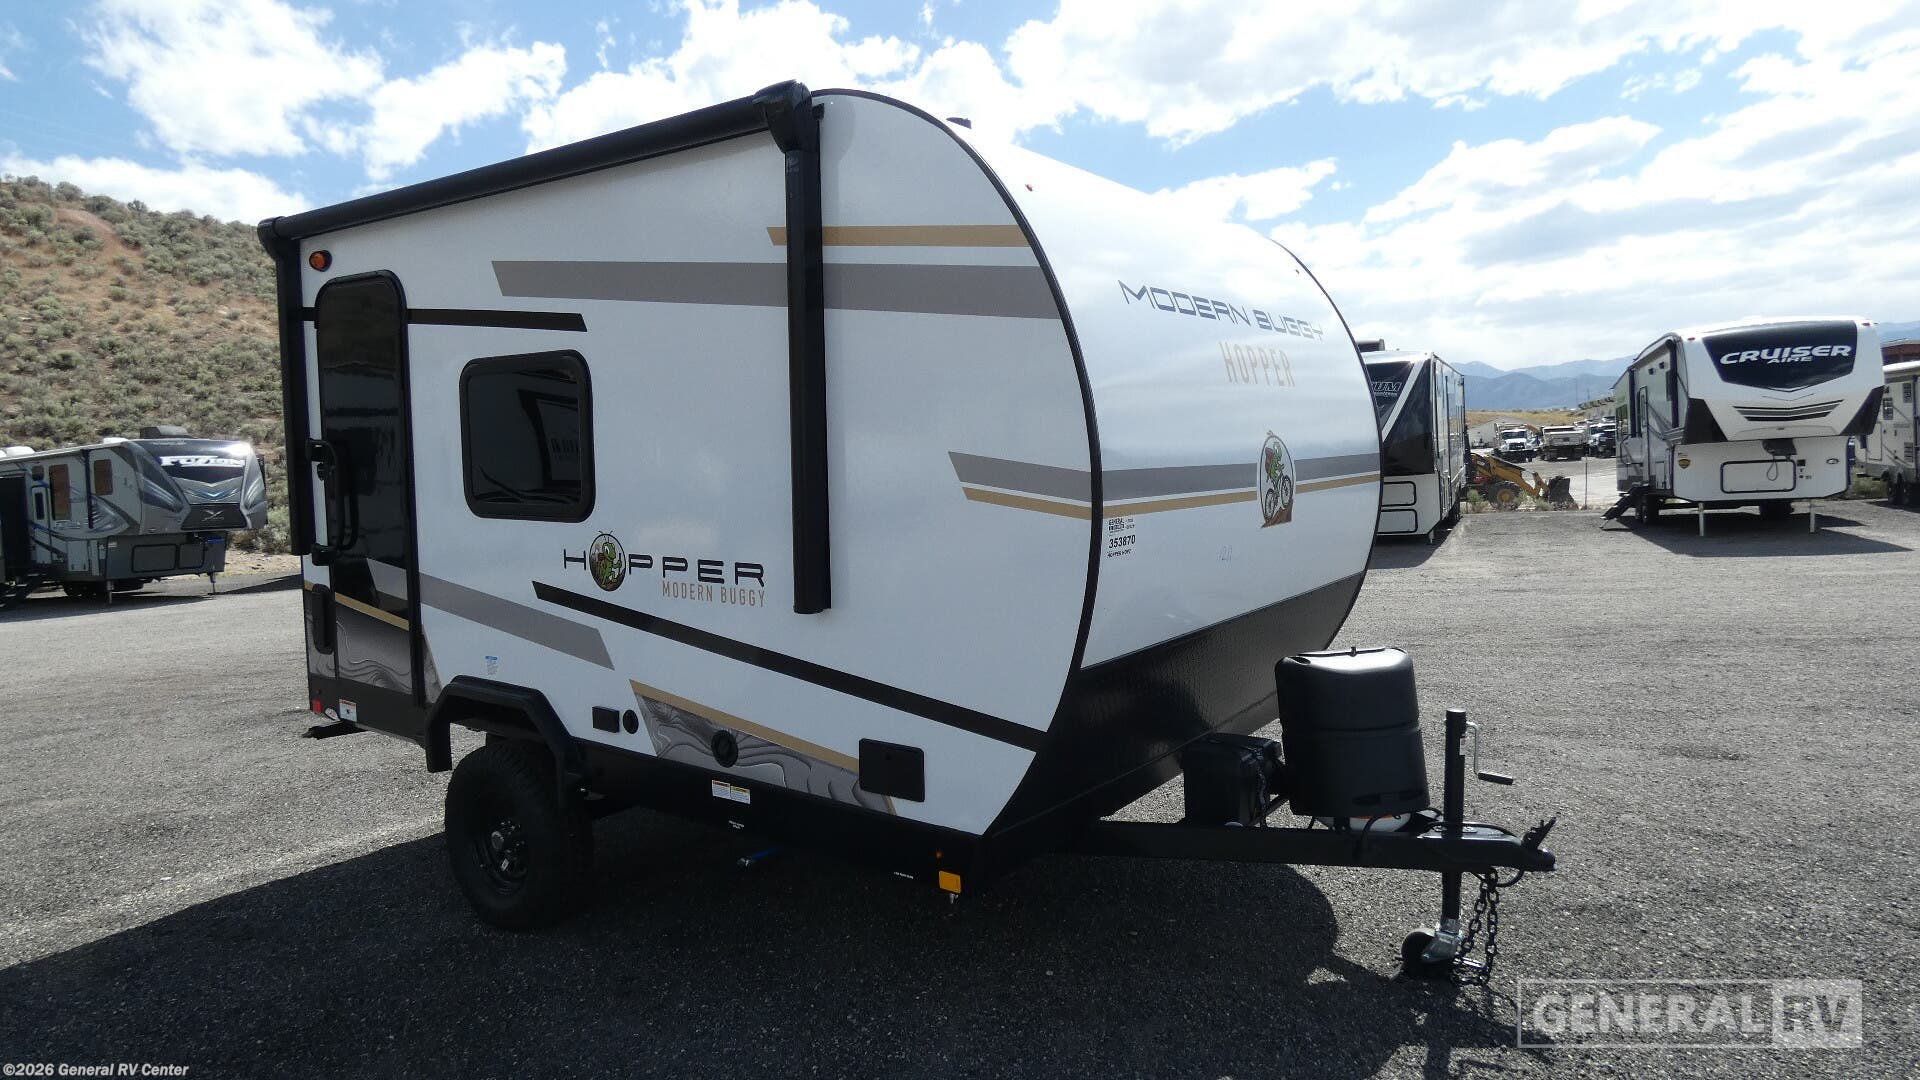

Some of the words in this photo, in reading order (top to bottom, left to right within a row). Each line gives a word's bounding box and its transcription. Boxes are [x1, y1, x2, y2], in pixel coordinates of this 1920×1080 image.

[1117, 279, 1252, 327] MODERN
[1252, 308, 1324, 341] BUGGY
[1218, 341, 1296, 388] HOPPER
[1720, 344, 1852, 365] CRUISER
[1767, 355, 1814, 365] AIRE
[159, 455, 246, 467] FUZION
[1108, 534, 1136, 549] 353870
[662, 580, 714, 602] MODERN
[720, 586, 765, 608] BUGGY
